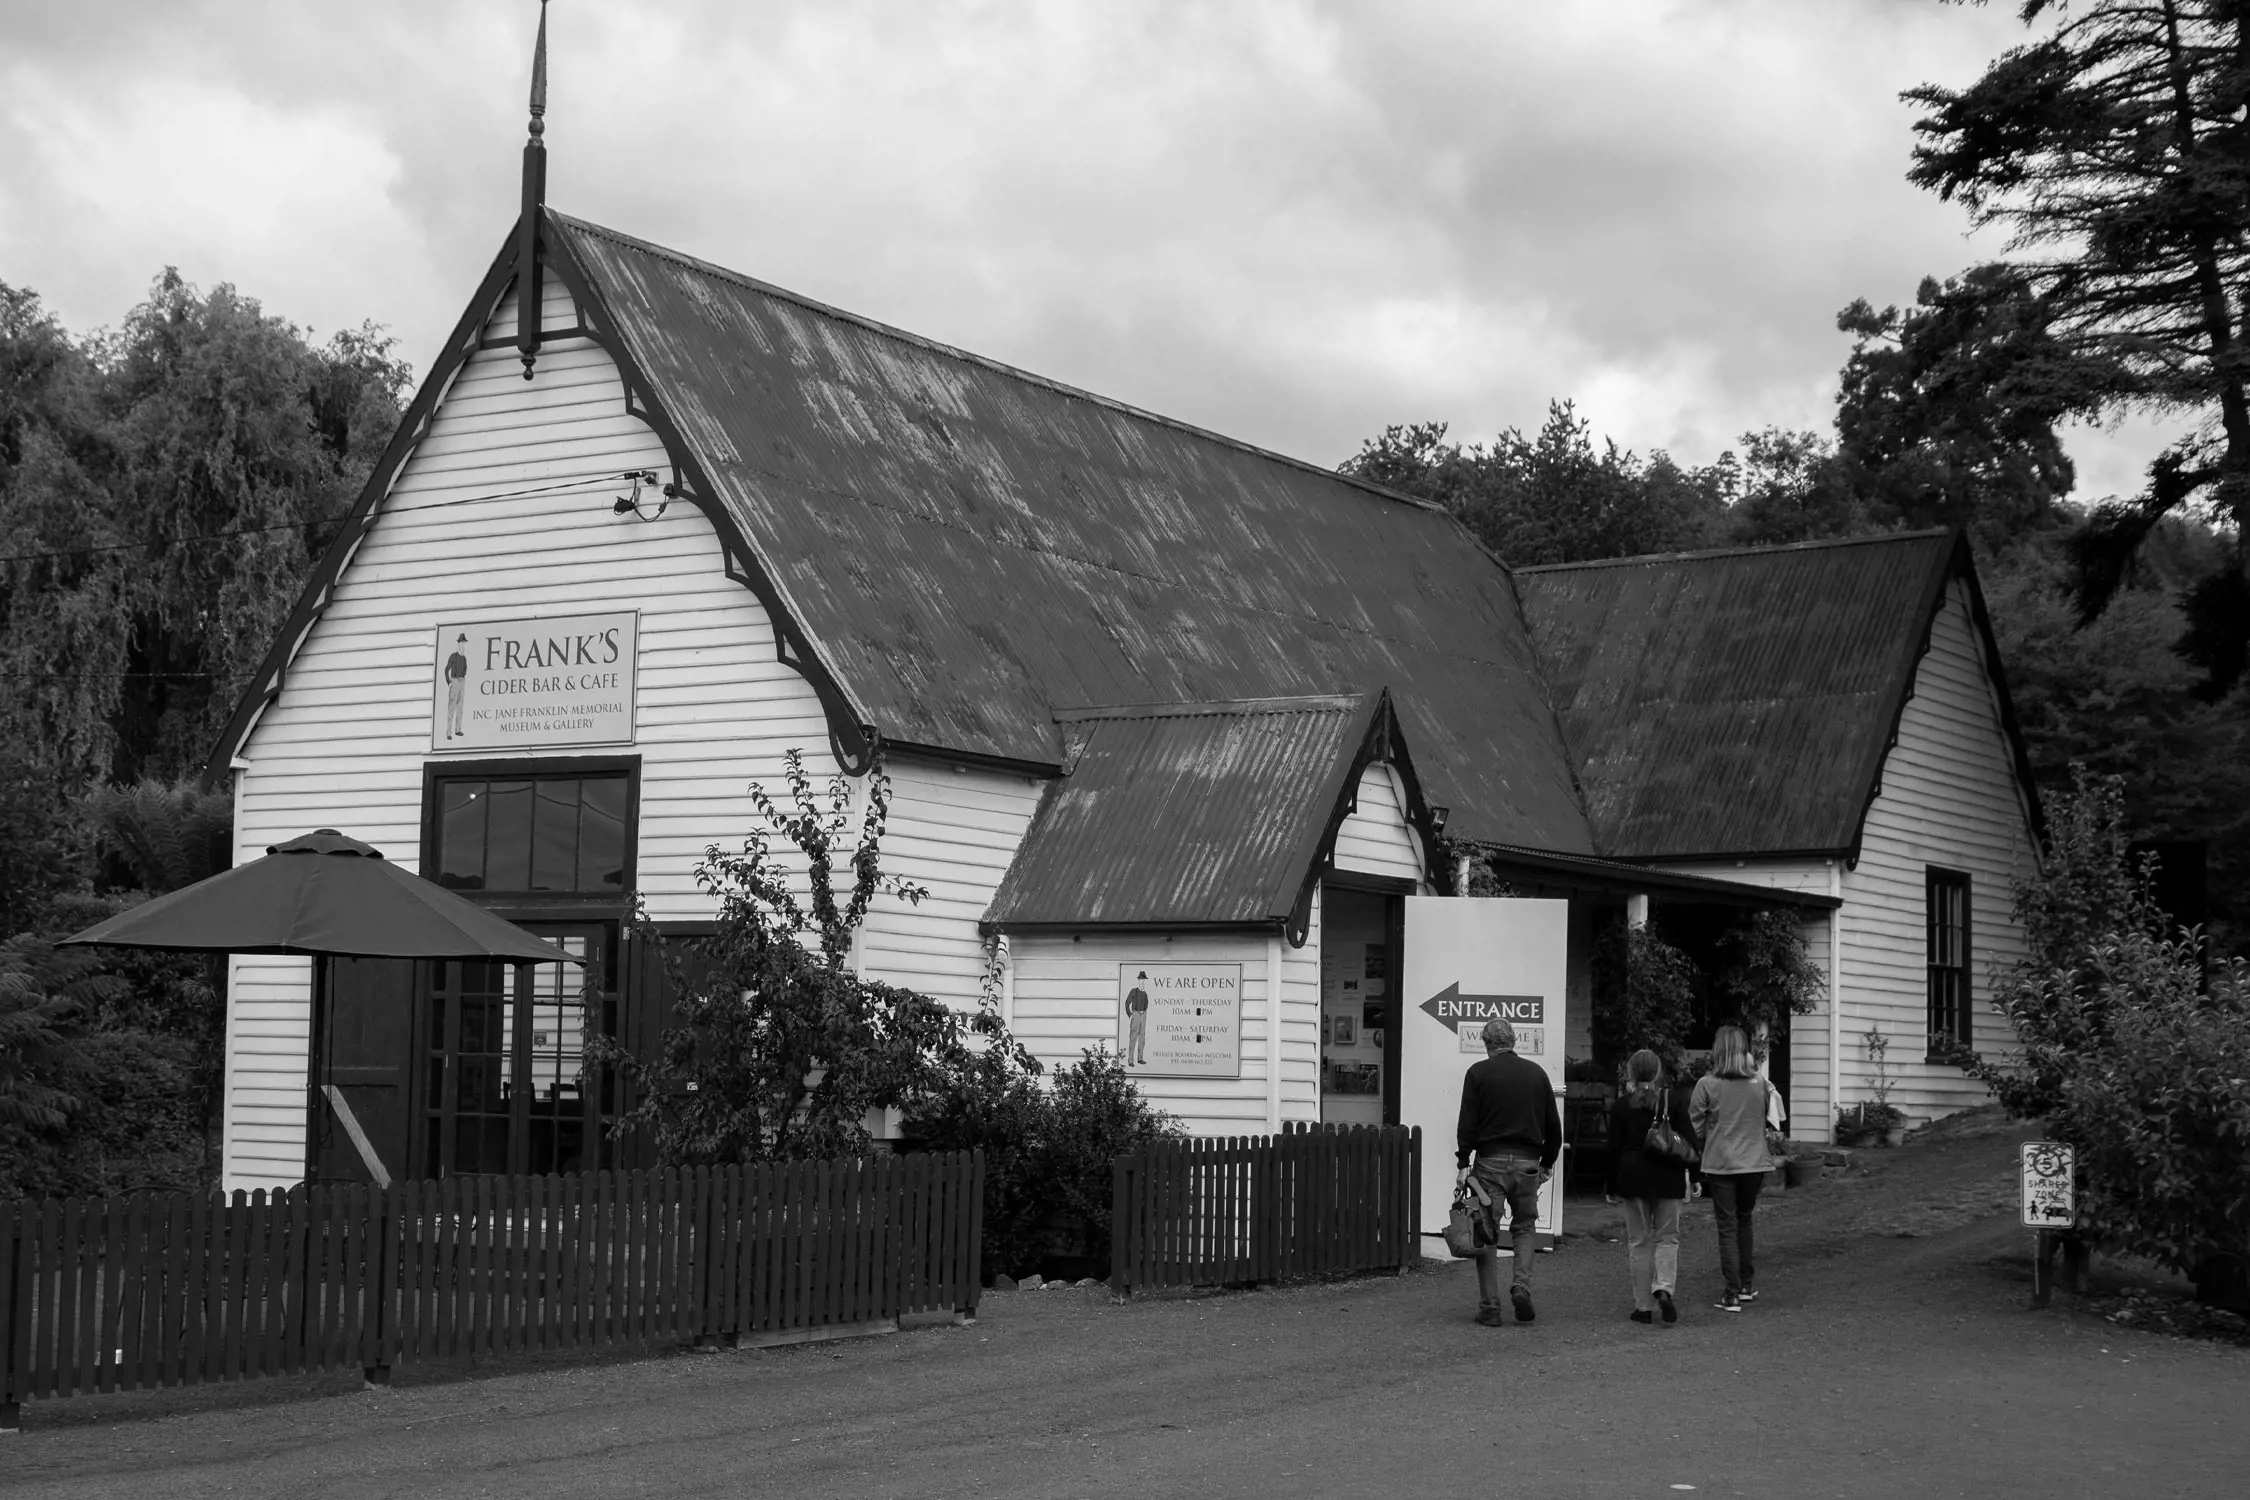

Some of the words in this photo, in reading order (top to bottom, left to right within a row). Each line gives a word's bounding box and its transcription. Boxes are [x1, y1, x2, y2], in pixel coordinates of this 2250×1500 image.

[484, 628, 619, 671] FRANK'S
[480, 678, 528, 696] CIDER
[532, 675, 562, 693] BAR
[564, 675, 577, 691] &
[580, 672, 620, 690] CAFE
[495, 707, 518, 721] JANE
[519, 704, 568, 718] FRANKLIN
[571, 702, 624, 715] MEMORIAL
[499, 721, 541, 733] MUSEUM
[543, 721, 552, 731] &
[553, 718, 595, 730] GALLERY
[1154, 977, 1172, 988] WE
[1175, 977, 1197, 988] ARE
[1201, 977, 1235, 988] OPEN
[1153, 998, 1185, 1006] SUNDAY
[1192, 998, 1232, 1006] THURSDAY
[1172, 1007, 1192, 1016] 10AM
[1196, 1007, 1213, 1016] PM
[1437, 1000, 1541, 1019] ENTRANCE
[1156, 1025, 1184, 1033] FRIDAY
[1190, 1025, 1229, 1033] SATURDAY
[1171, 1034, 1191, 1043] 10AM
[1196, 1034, 1213, 1043] PM
